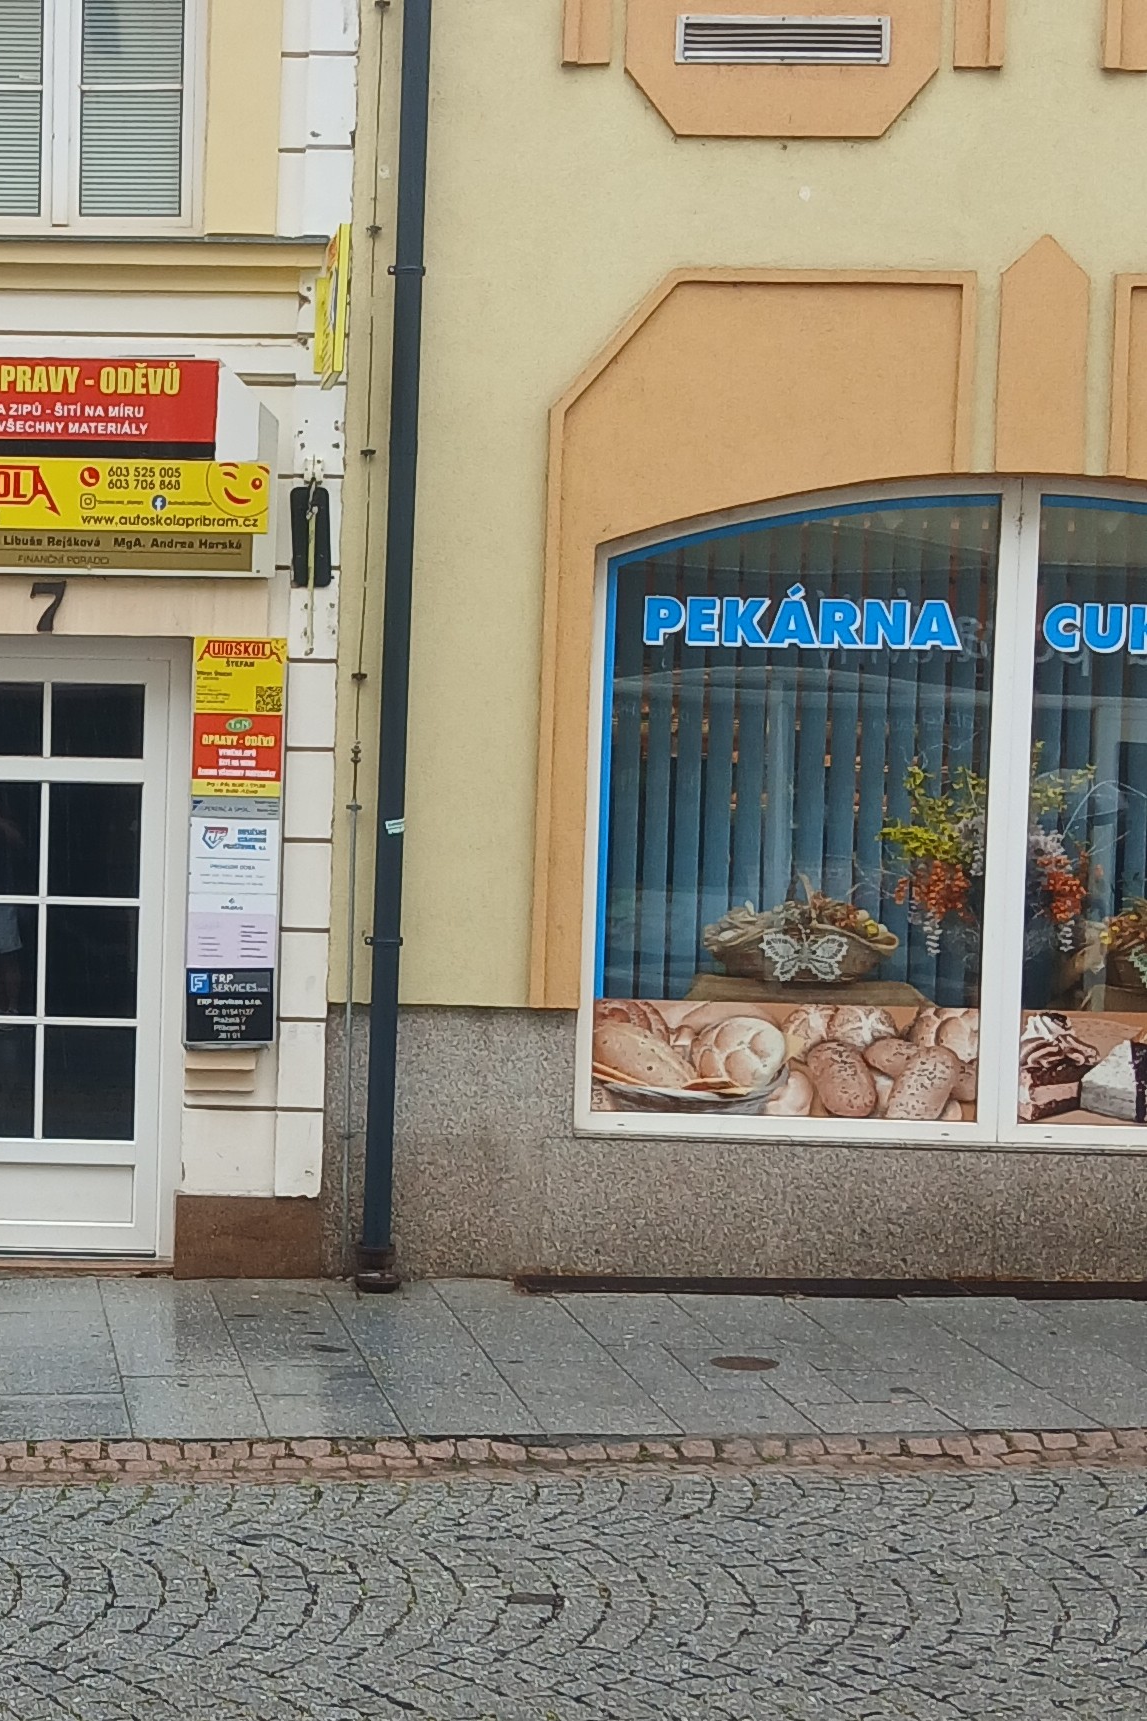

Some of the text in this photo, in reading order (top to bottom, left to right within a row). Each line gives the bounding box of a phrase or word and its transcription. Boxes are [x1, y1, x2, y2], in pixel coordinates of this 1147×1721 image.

[100, 362, 180, 395] ODĚVŮ
[9, 402, 42, 416] ZIPŮ
[54, 402, 81, 417] ŠITÍ
[85, 405, 105, 417] NA
[109, 403, 144, 418] MÍRU
[68, 420, 149, 435] MATERIÁLY
[108, 466, 181, 478] 603 525 005
[108, 479, 130, 490] 603
[134, 479, 155, 490] 706
[81, 513, 259, 528] www.autoskolapribram.cz
[3, 535, 43, 547] Libuše
[113, 536, 145, 549] MgA.
[150, 537, 194, 550] Andrea
[30, 580, 67, 632] 7
[642, 582, 962, 651] PEKÁRNA
[212, 973, 234, 983] FRP
